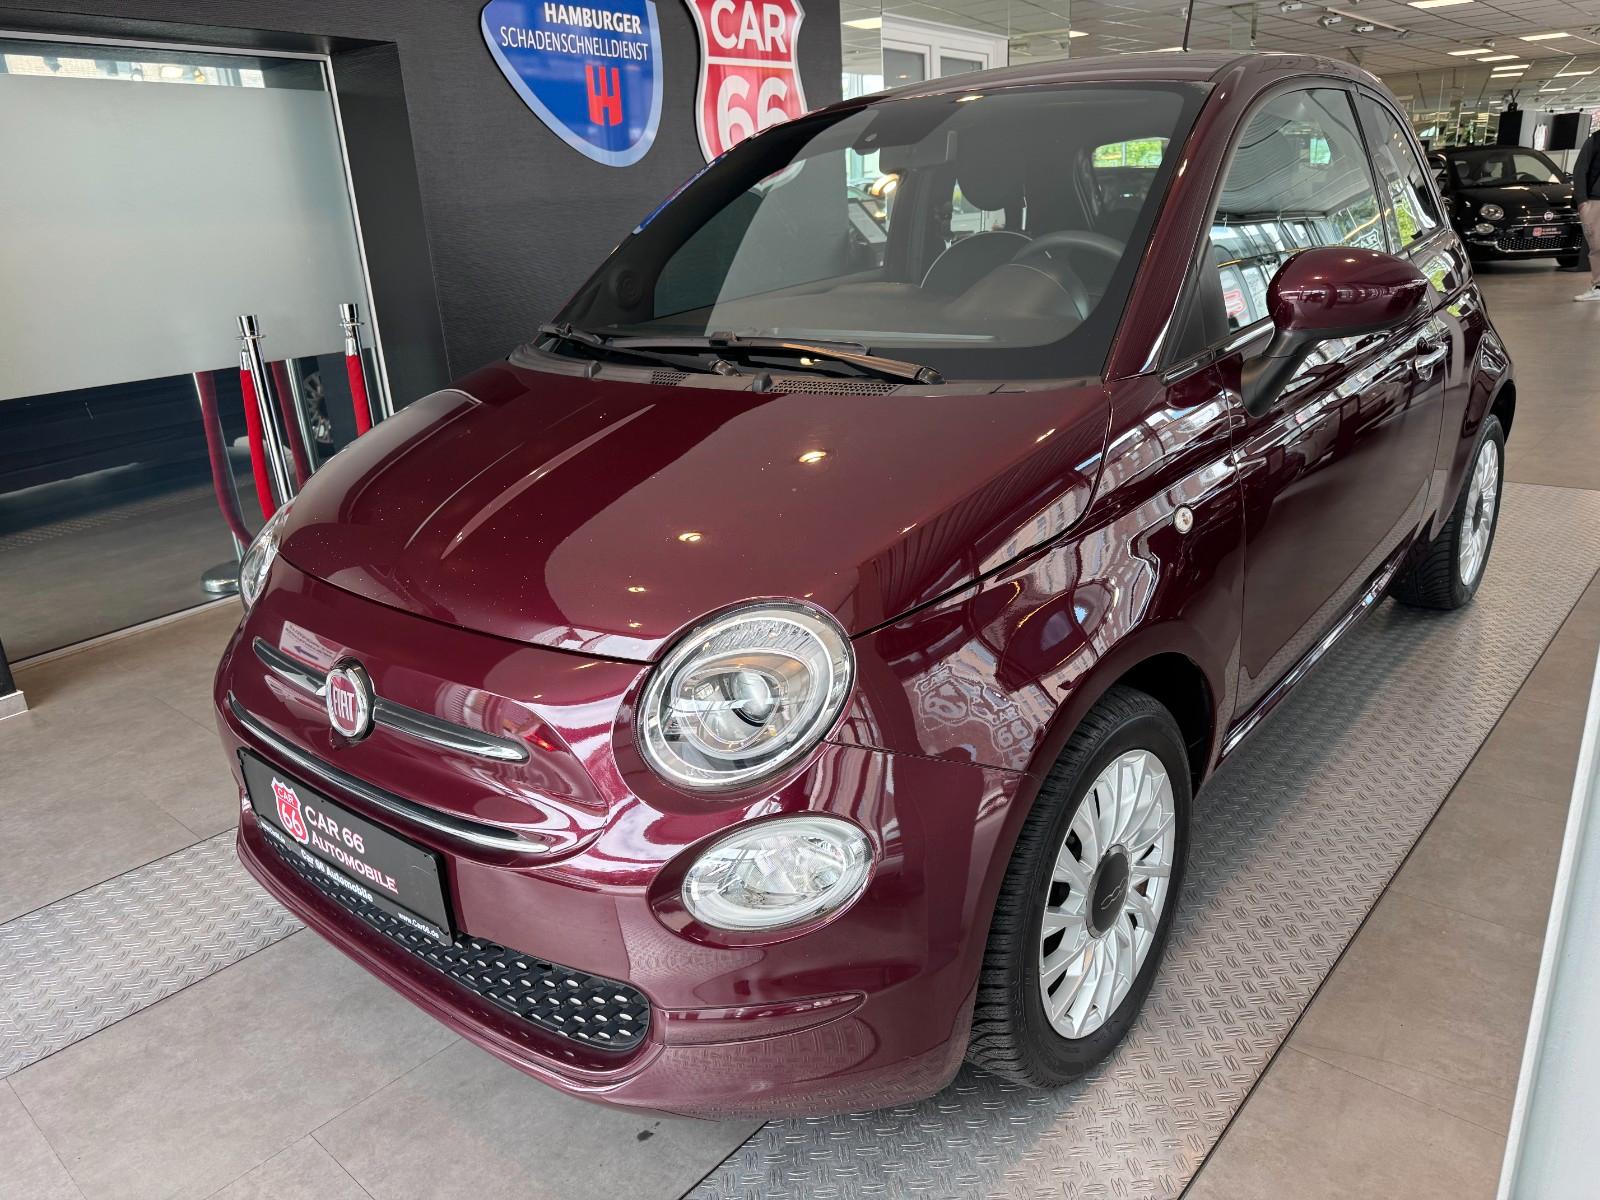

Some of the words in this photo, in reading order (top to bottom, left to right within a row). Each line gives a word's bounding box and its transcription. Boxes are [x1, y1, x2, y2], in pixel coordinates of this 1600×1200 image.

[543, 2, 642, 35] HAMBURGER
[710, 0, 787, 53] CAR
[499, 26, 648, 61] SCHADENSCHNELLDIENST
[332, 686, 354, 722] FIAT
[277, 788, 294, 804] CAR
[281, 803, 304, 837] 66
[304, 805, 341, 840] CAR
[342, 827, 365, 854] 66
[311, 831, 398, 893] AUTOMOBILE
[326, 867, 374, 902] Automobile
